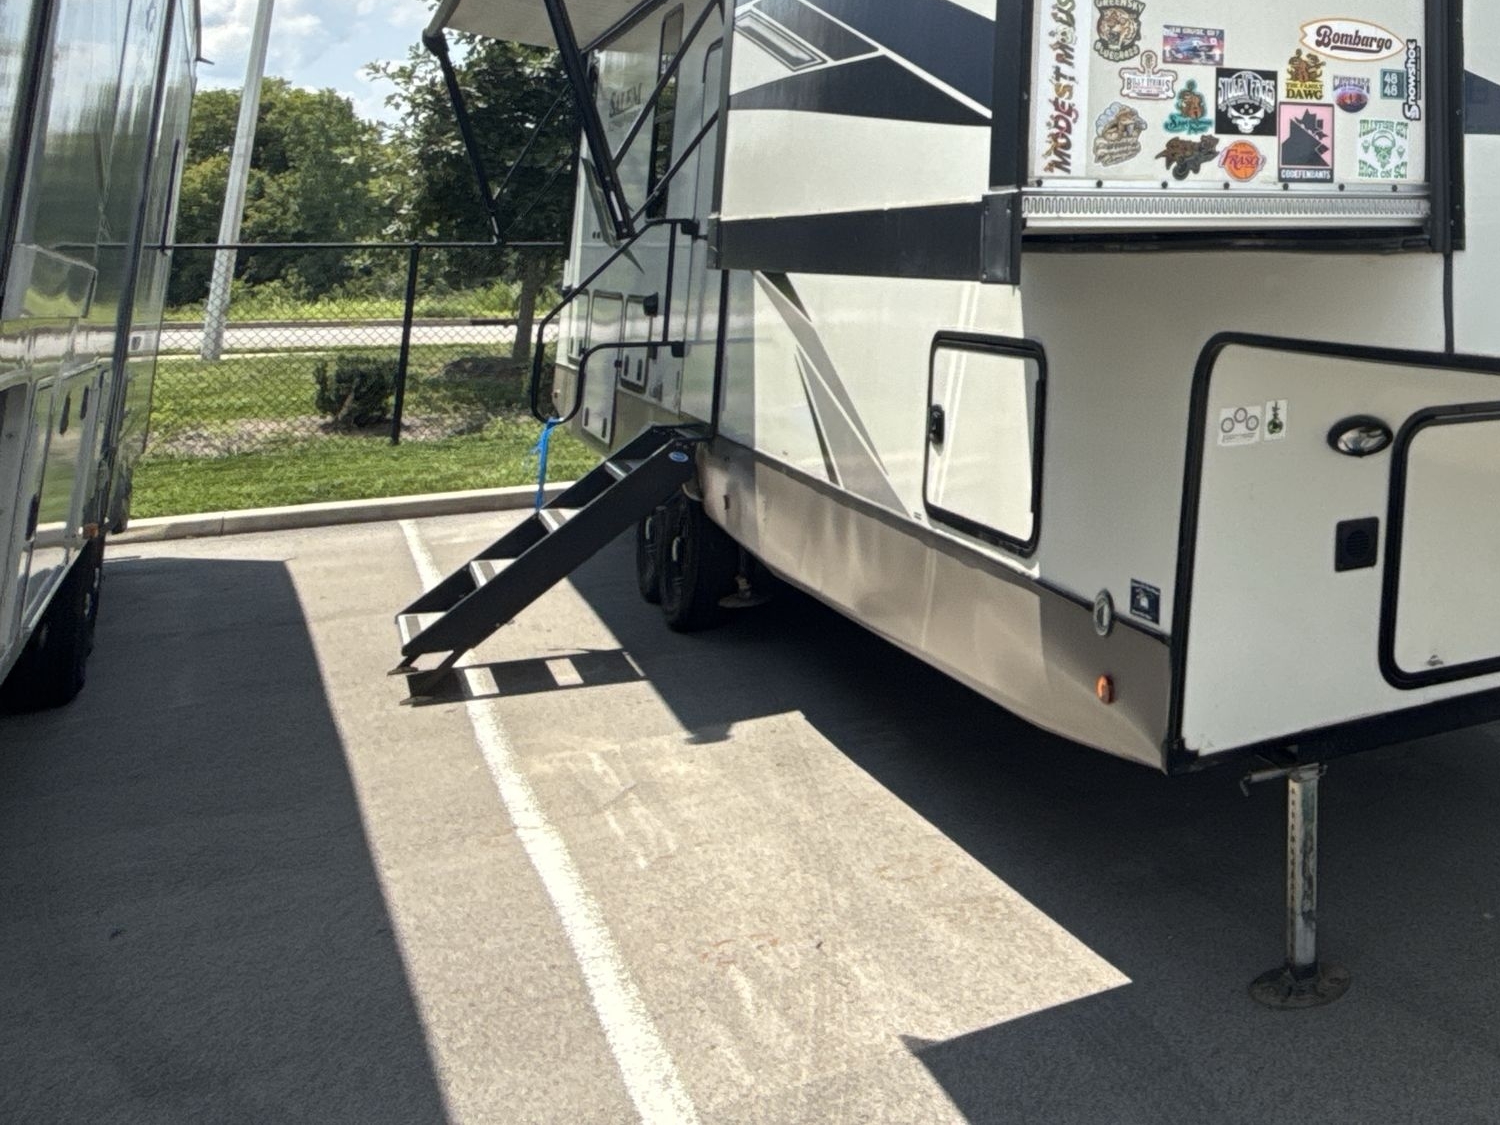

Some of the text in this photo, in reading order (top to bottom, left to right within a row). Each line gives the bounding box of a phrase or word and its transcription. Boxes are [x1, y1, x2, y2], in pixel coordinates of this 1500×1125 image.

[1315, 25, 1393, 53] Bombargo
[1095, 41, 1139, 60] BLUEGRASS
[1383, 73, 1398, 84] 48
[1403, 39, 1420, 120] Snowshoe
[1286, 89, 1324, 100] DAWG
[1383, 85, 1398, 96] 48
[1043, 65, 1078, 174] MODEST
[1280, 169, 1331, 180] CODEFENDANTS
